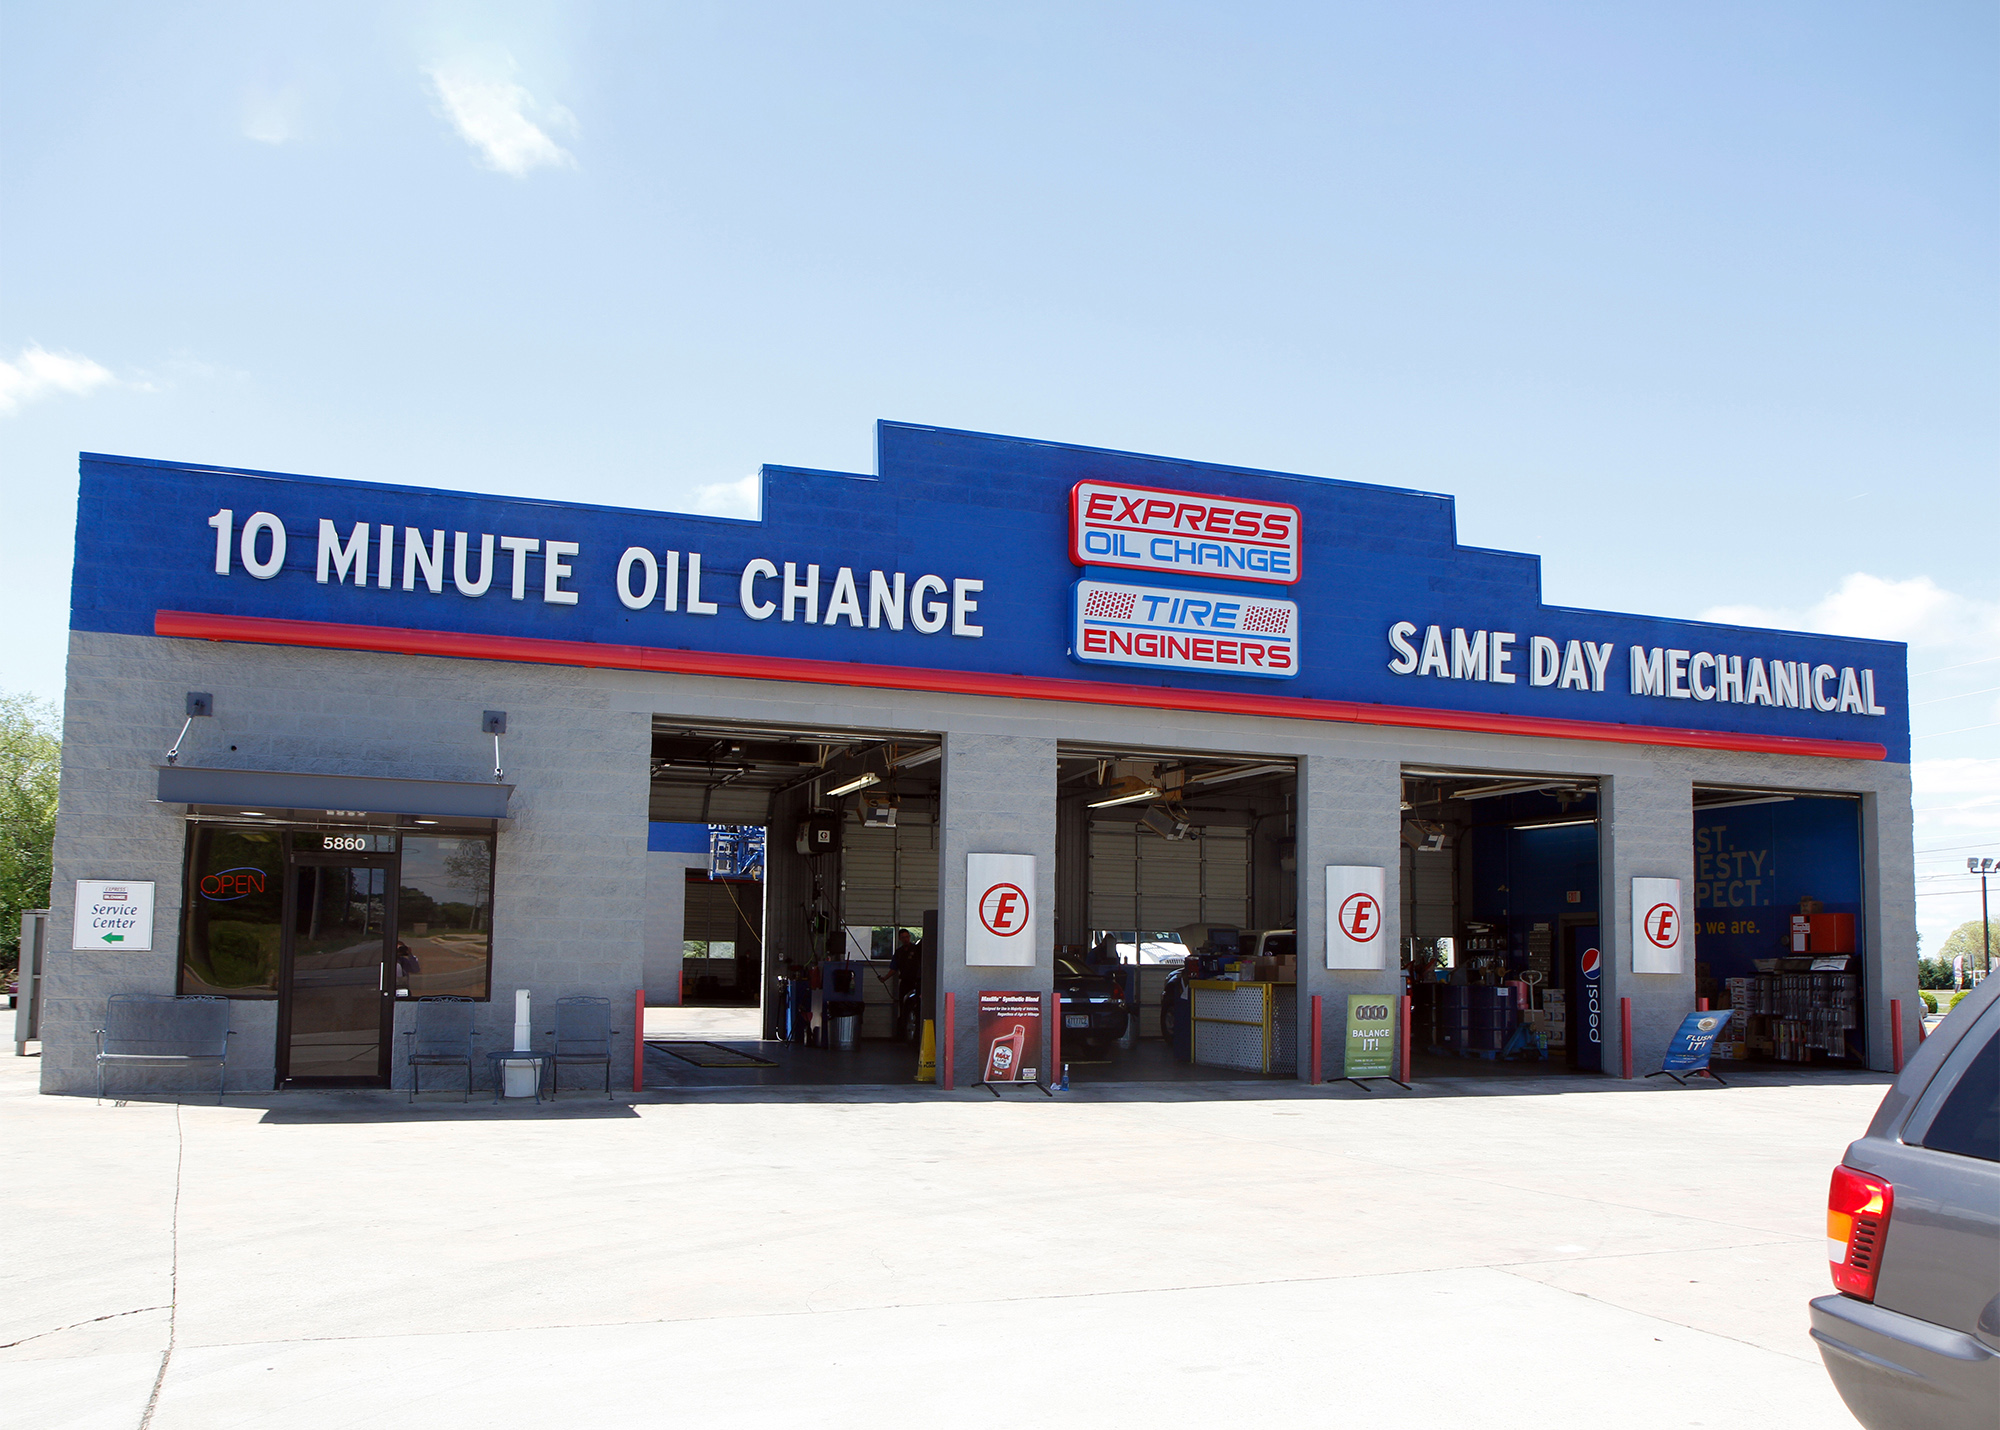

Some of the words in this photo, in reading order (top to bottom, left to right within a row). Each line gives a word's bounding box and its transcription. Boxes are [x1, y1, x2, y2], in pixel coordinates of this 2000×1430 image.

[1085, 493, 1291, 540] EXPRESS
[1085, 531, 1141, 558] OIL
[1150, 538, 1291, 574] CHANGE
[208, 508, 286, 580] 10
[316, 518, 580, 605] MINUTE
[616, 546, 718, 615] OIL
[739, 558, 984, 638] CHANGE
[1142, 595, 1240, 629] TIRE
[1084, 628, 1292, 668] ENGINEERS
[1387, 621, 1516, 684] SAME
[1530, 636, 1614, 692] DAY
[1630, 645, 1886, 716] MECHANICAL
[323, 837, 366, 851] 5860
[1696, 825, 1734, 854] ST.
[1696, 850, 1774, 880] ESTY.
[200, 874, 265, 894] OPEN
[1695, 879, 1769, 908] PECT.
[91, 904, 138, 915] Service
[93, 918, 136, 928] Center
[993, 893, 1018, 928] E
[1352, 901, 1372, 934] E
[1656, 911, 1673, 940] E
[1706, 922, 1726, 934] we
[1731, 921, 1760, 934] are.
[1586, 984, 1601, 1043] pepsi
[1352, 1029, 1390, 1038] BALANCE
[1363, 1038, 1379, 1051] IT!
[995, 1052, 1011, 1061] MAX
